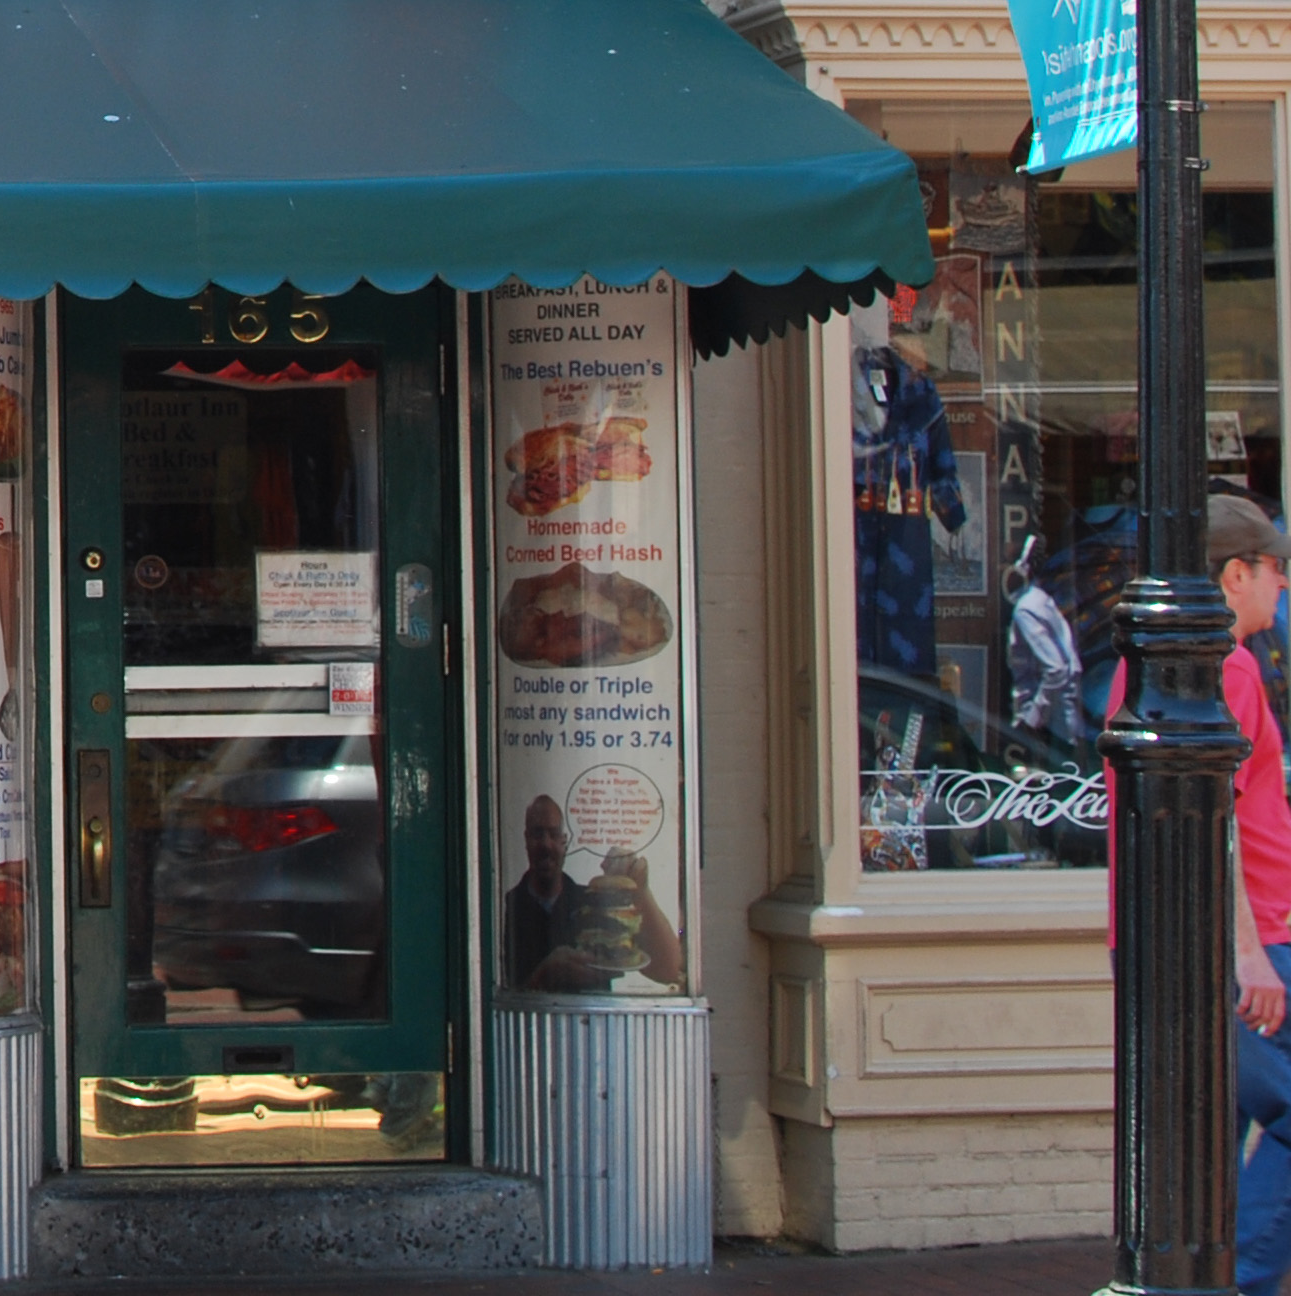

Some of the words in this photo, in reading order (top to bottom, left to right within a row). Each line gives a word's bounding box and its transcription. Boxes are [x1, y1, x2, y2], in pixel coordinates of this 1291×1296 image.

[537, 303, 599, 319] DINNER
[508, 327, 563, 344] SERVED
[569, 325, 602, 341] ALL
[608, 324, 644, 340] DAY
[501, 364, 522, 380] The
[527, 362, 562, 379] Best
[527, 518, 627, 536] Homemade
[561, 544, 603, 561] Beef
[610, 544, 662, 561] Hash
[514, 676, 565, 693] Double
[570, 680, 589, 693] or
[595, 676, 653, 697] Triple
[539, 707, 568, 724] any
[574, 704, 670, 721] sandwich
[523, 729, 553, 751] only
[560, 730, 596, 747] 1.95
[602, 733, 623, 747] or
[630, 731, 673, 748] 3.74
[946, 771, 1049, 828] The
